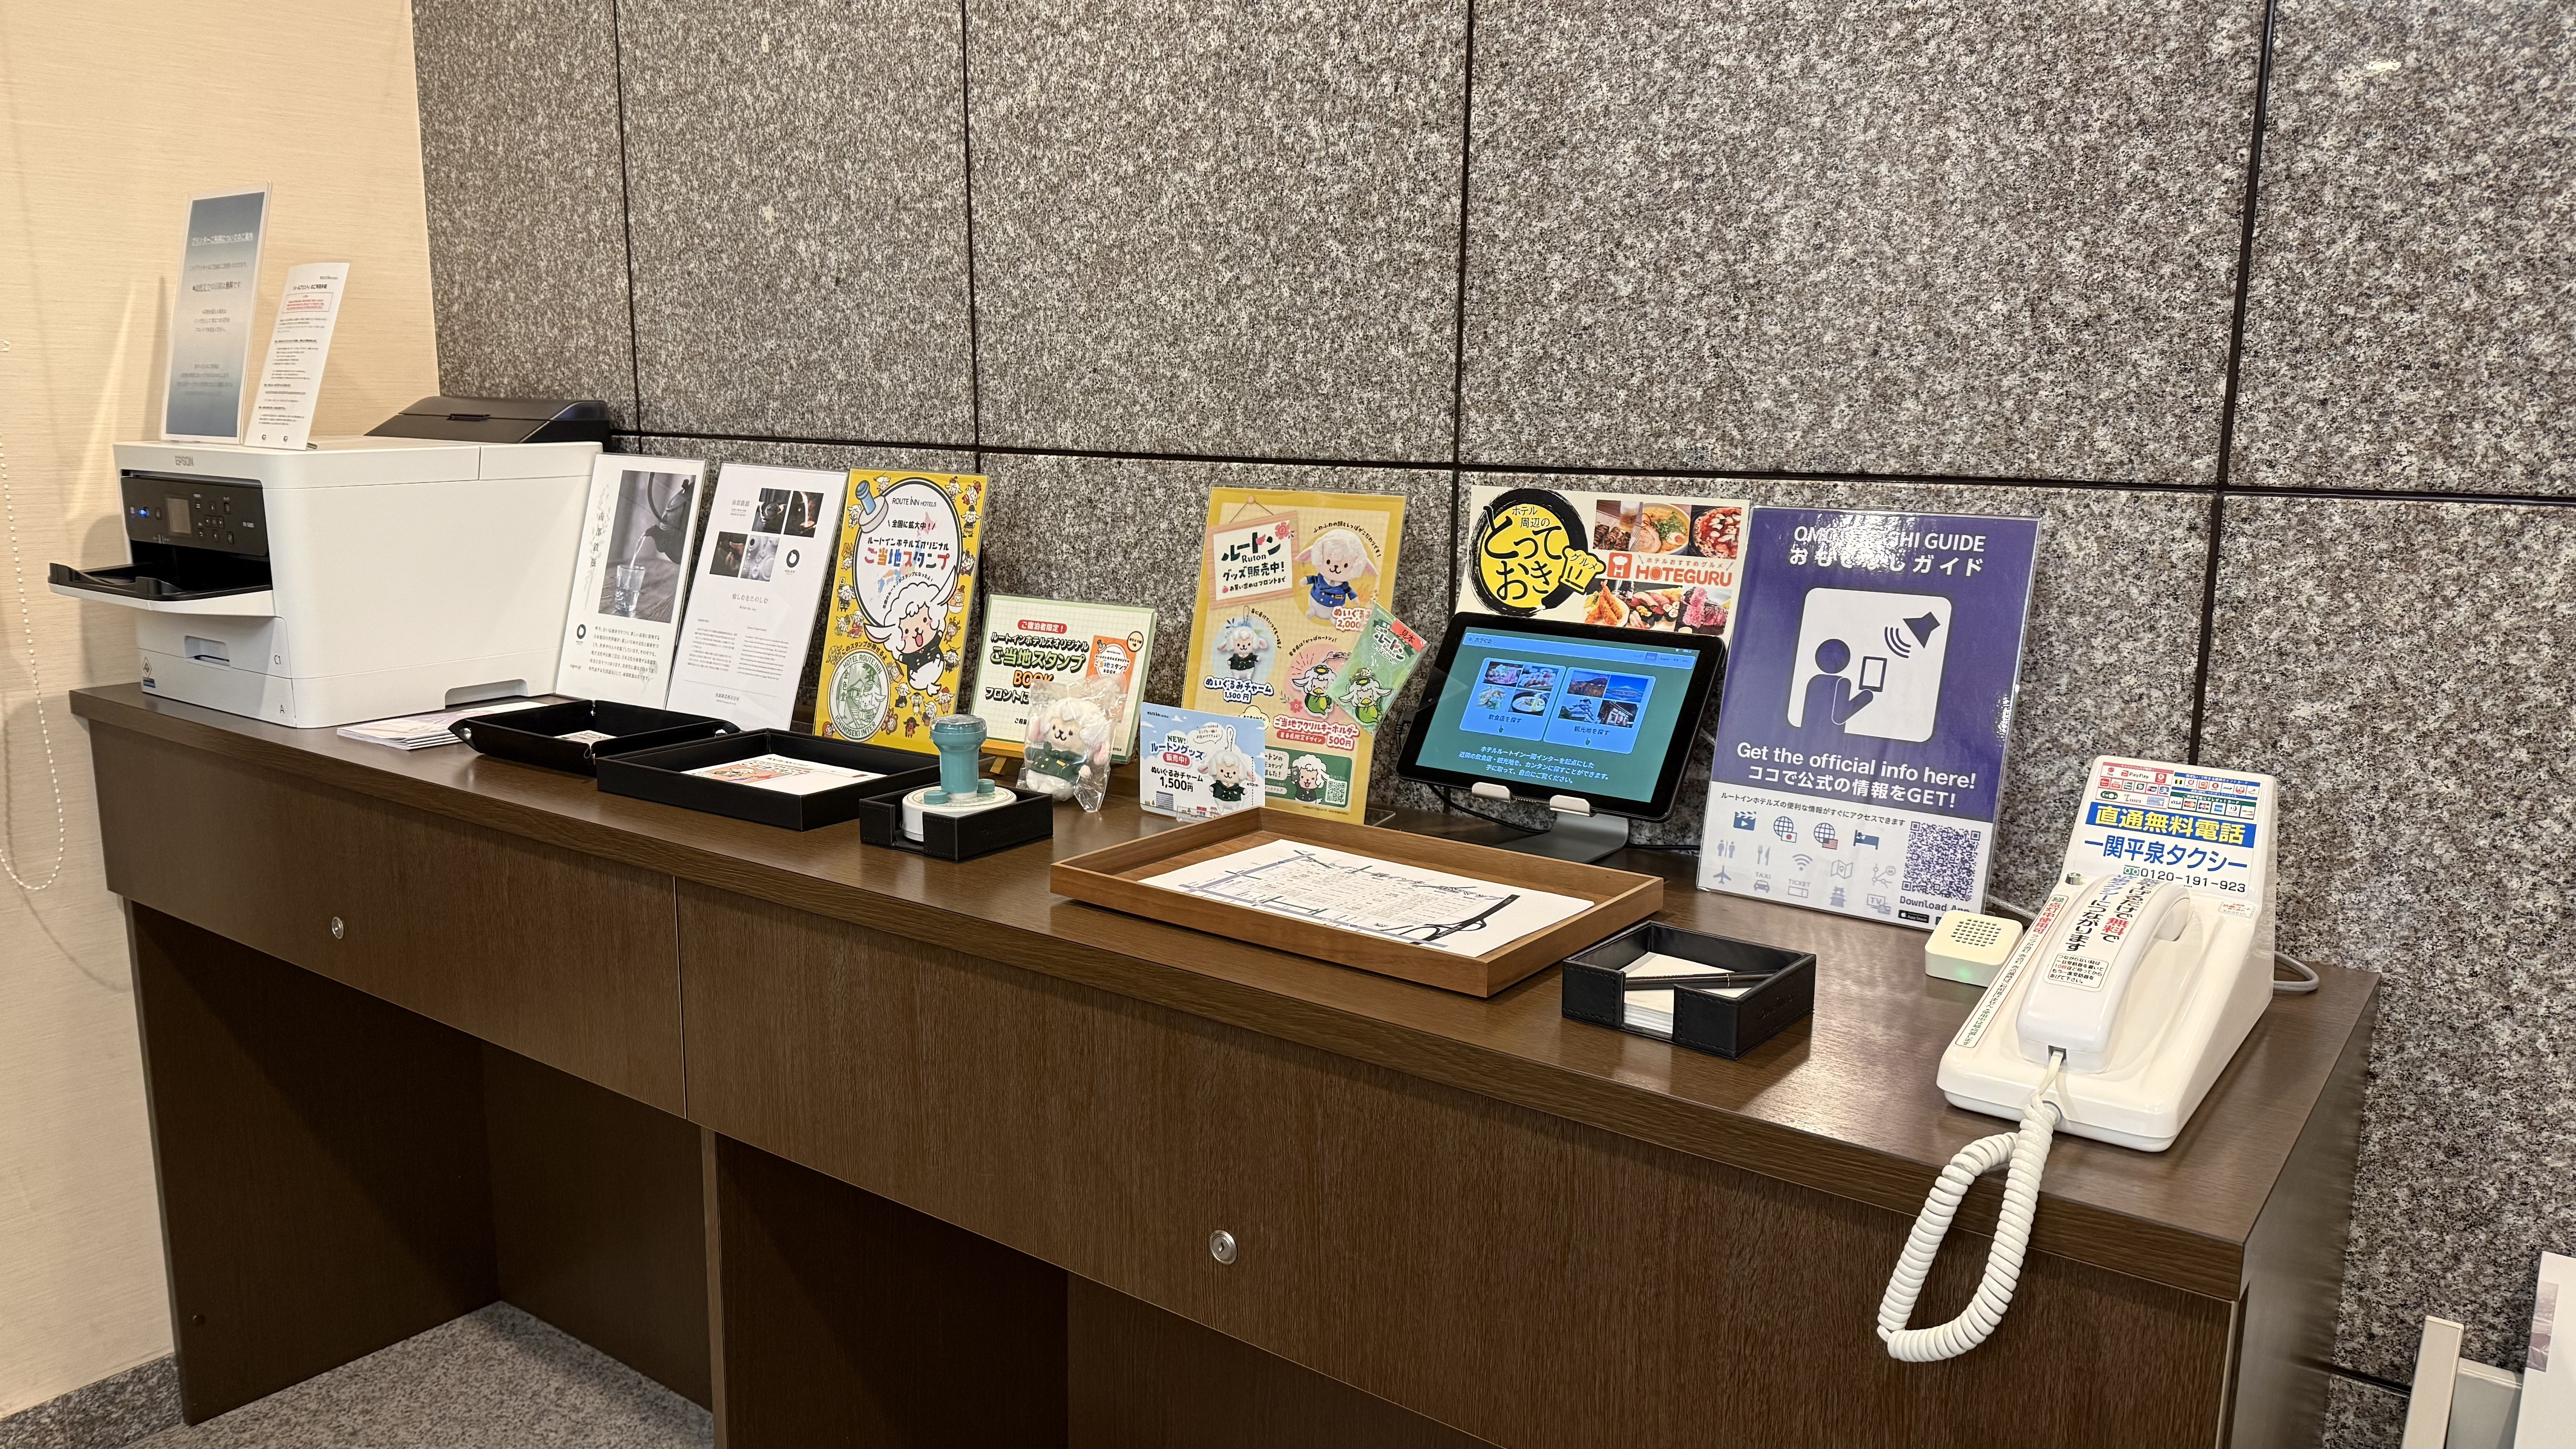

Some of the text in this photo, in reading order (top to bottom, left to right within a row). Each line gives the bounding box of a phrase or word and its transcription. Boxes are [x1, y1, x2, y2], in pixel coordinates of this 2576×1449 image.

[175, 455, 194, 467] EPSON
[910, 496, 920, 506] INN
[1512, 506, 1538, 516] ホテル
[1520, 517, 1550, 528] 周辺の
[1483, 506, 1562, 560] とって
[868, 537, 949, 551] ルートインホテルズオリジナル
[1221, 532, 1281, 561] ルートン
[1925, 532, 1986, 553] GUIDE
[865, 547, 950, 570] ご当地スタンプ
[1242, 554, 1266, 563] Ruton
[1570, 553, 1598, 570] グルメ
[1647, 557, 1723, 569] ホテルおすすめグルメ
[1789, 547, 1984, 578] おもし ガイド
[1223, 561, 1284, 581] グッズ販売中!
[1636, 565, 1732, 587] HOTEGURU
[1230, 576, 1286, 591] お買い求めはフロントまで
[1495, 560, 1553, 601] おき
[1021, 621, 1063, 632] ご宿泊者限定！
[1337, 620, 1363, 629] 2,000
[991, 632, 1090, 653] ルートインホテルズオリジナル
[1400, 630, 1415, 643] 見本
[842, 641, 887, 661] このスタンプが押せるよ
[1374, 633, 1404, 660] ルートン
[274, 655, 281, 665] C1
[843, 654, 883, 674] HOTEL ROUTE INN
[990, 646, 1086, 673] ご当地スタンプ
[1205, 678, 1272, 694] ぬいぐるみチャーム
[1224, 691, 1249, 701] 1,500円
[280, 704, 285, 715] A
[835, 715, 877, 737] ICHINOSEKI INTER
[1275, 717, 1357, 734] ご当地アクリルキーホルダー
[1488, 714, 1522, 723] 飲食店を探す
[1574, 726, 1610, 735] 観光地を探す
[1167, 735, 1186, 745] NEW!
[1329, 736, 1351, 747] 500円
[1151, 743, 1205, 761] ルートングッズ
[1166, 754, 1187, 764] 販売中!
[1481, 746, 1594, 769] ホテルルートイン一関インターを起点にした
[1151, 766, 1204, 782] ぬいぐるみチャーム
[1486, 764, 1573, 784] 手に取って、自由にご覧ください。
[1737, 742, 1976, 789] Get the official info here!
[1160, 776, 1194, 792] 1,500円
[1748, 766, 1955, 808] ココで公式の情報をGET!
[1721, 792, 1906, 826] ルートインホテルズの便利な情報がすぐにアクセスできます
[2095, 805, 2245, 845] 直通無料電話
[2084, 835, 2247, 872] 一関平泉タクシー
[1788, 878, 1811, 888] TICKET
[2140, 868, 2246, 893] 0120-191-923
[1900, 896, 1947, 911] Download
[2033, 897, 2065, 934] 緑点灯中使用可
[2058, 955, 2100, 966] つながらない時は
